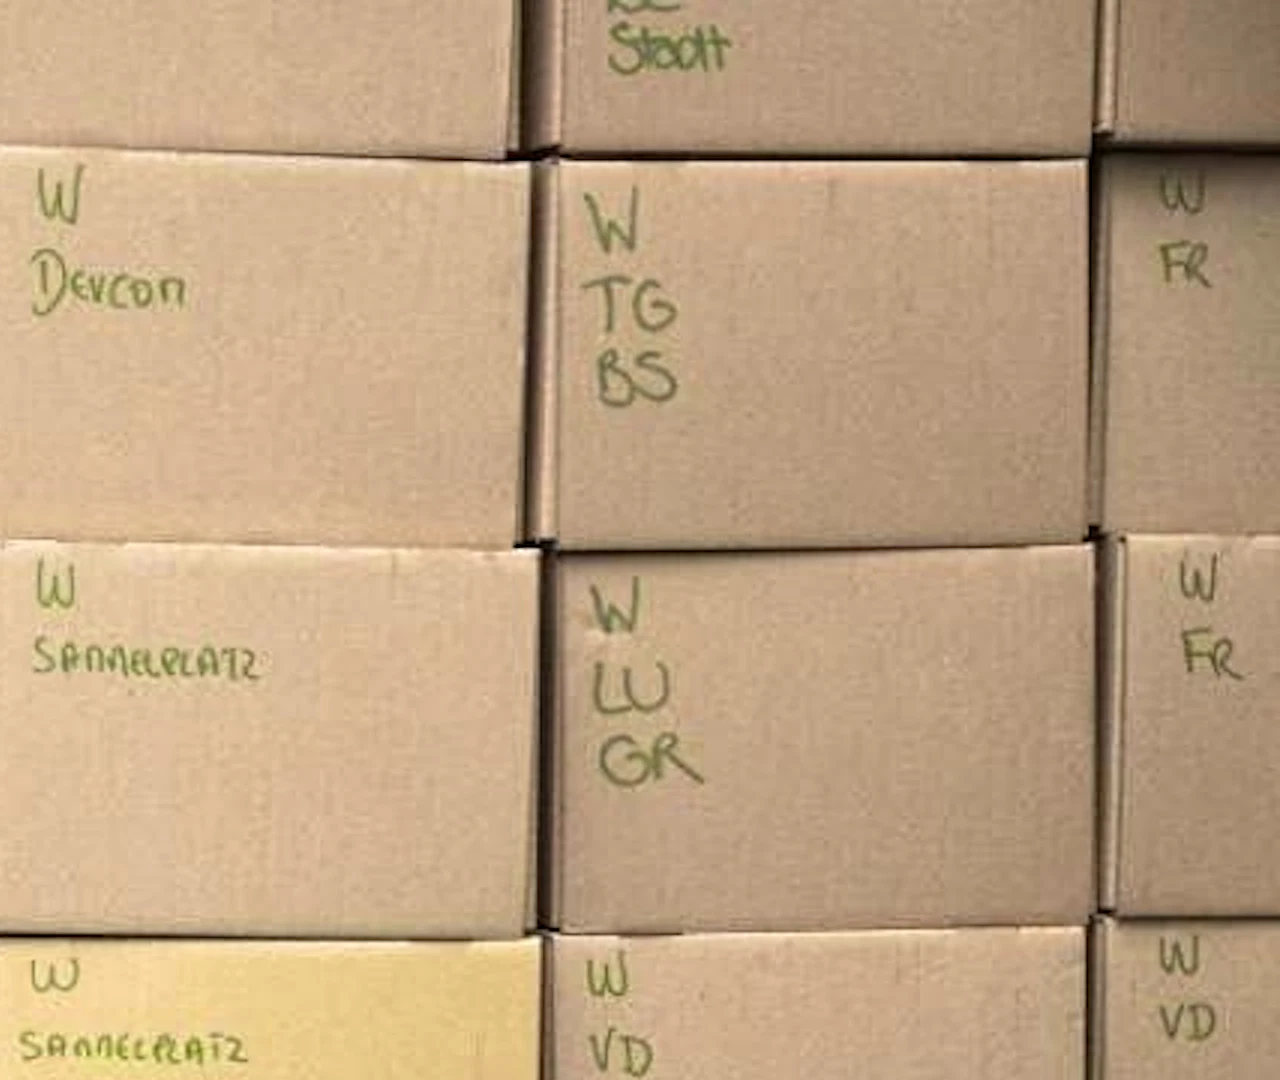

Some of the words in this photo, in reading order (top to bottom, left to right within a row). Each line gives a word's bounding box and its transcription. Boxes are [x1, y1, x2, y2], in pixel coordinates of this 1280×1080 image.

[38, 165, 84, 225] W
[1158, 172, 1207, 214] W
[584, 187, 638, 254] W
[1159, 240, 1211, 288] FR
[582, 275, 677, 334] TG
[597, 349, 677, 408] BS
[37, 560, 75, 609] W
[590, 576, 641, 634] W
[1180, 555, 1217, 604] W
[1181, 627, 1244, 681] FR
[591, 662, 670, 717] LU
[599, 733, 704, 787] GR
[31, 958, 80, 993] W
[587, 951, 628, 997] W
[1159, 933, 1200, 975] W
[1160, 1003, 1216, 1042] VD
[588, 1027, 652, 1078] VD
